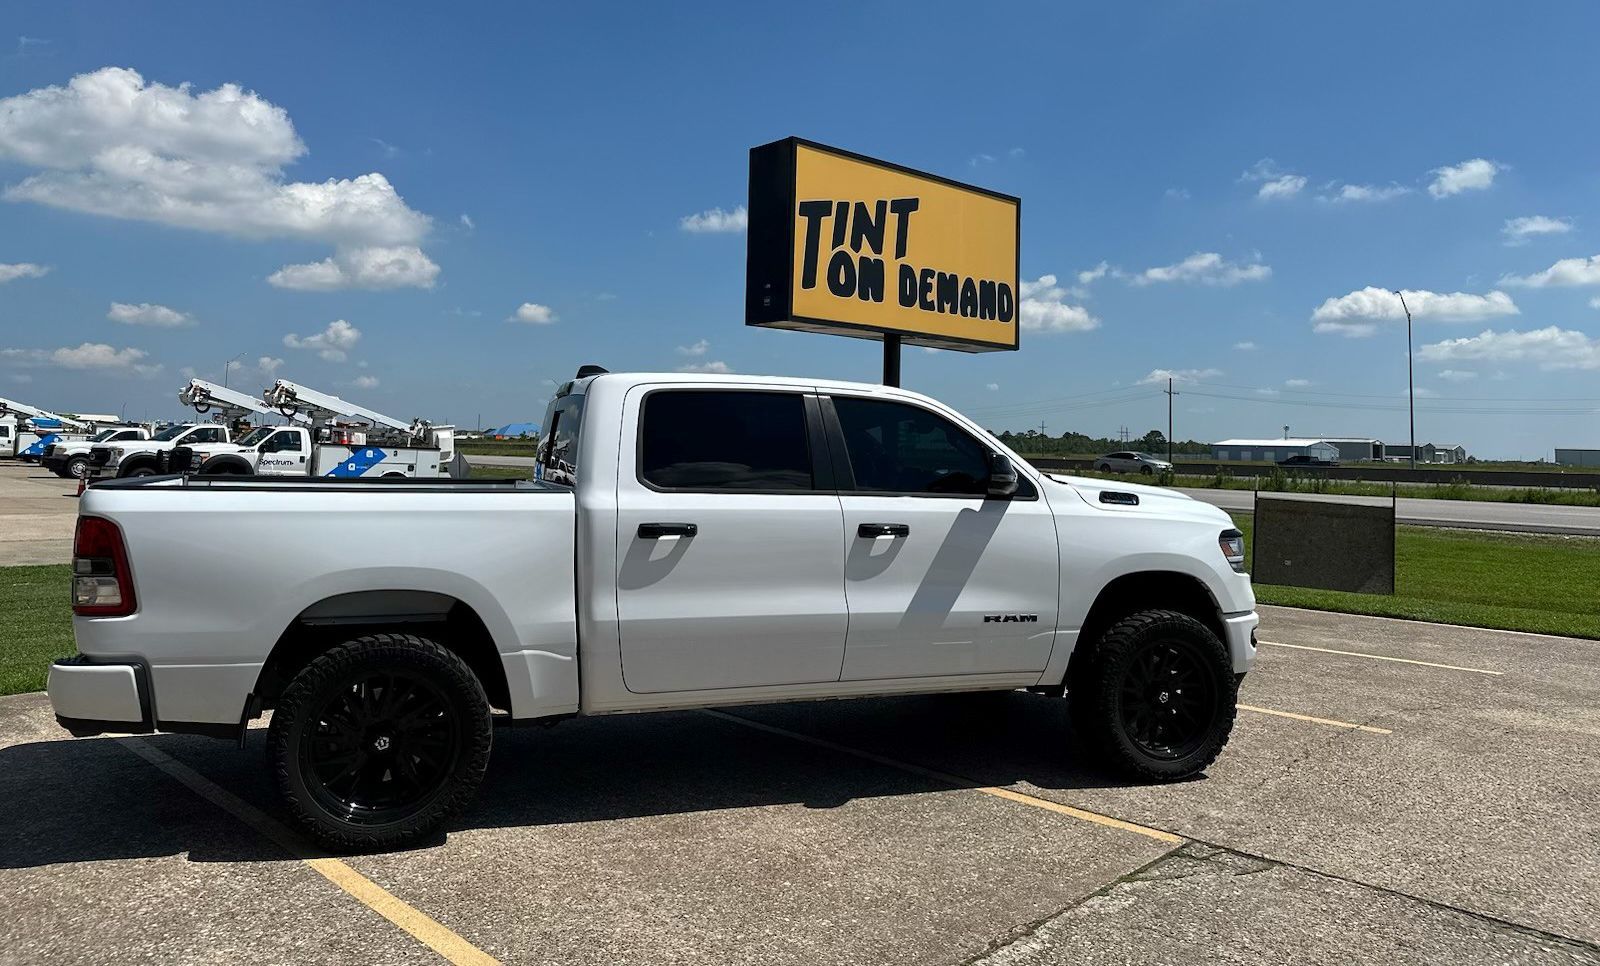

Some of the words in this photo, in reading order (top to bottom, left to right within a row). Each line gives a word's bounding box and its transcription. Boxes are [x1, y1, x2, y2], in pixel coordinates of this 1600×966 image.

[798, 197, 920, 290] TINT
[826, 250, 885, 303] ON
[898, 263, 1014, 323] DEMAND
[259, 458, 293, 467] Spectrum
[983, 613, 1038, 623] RAM
